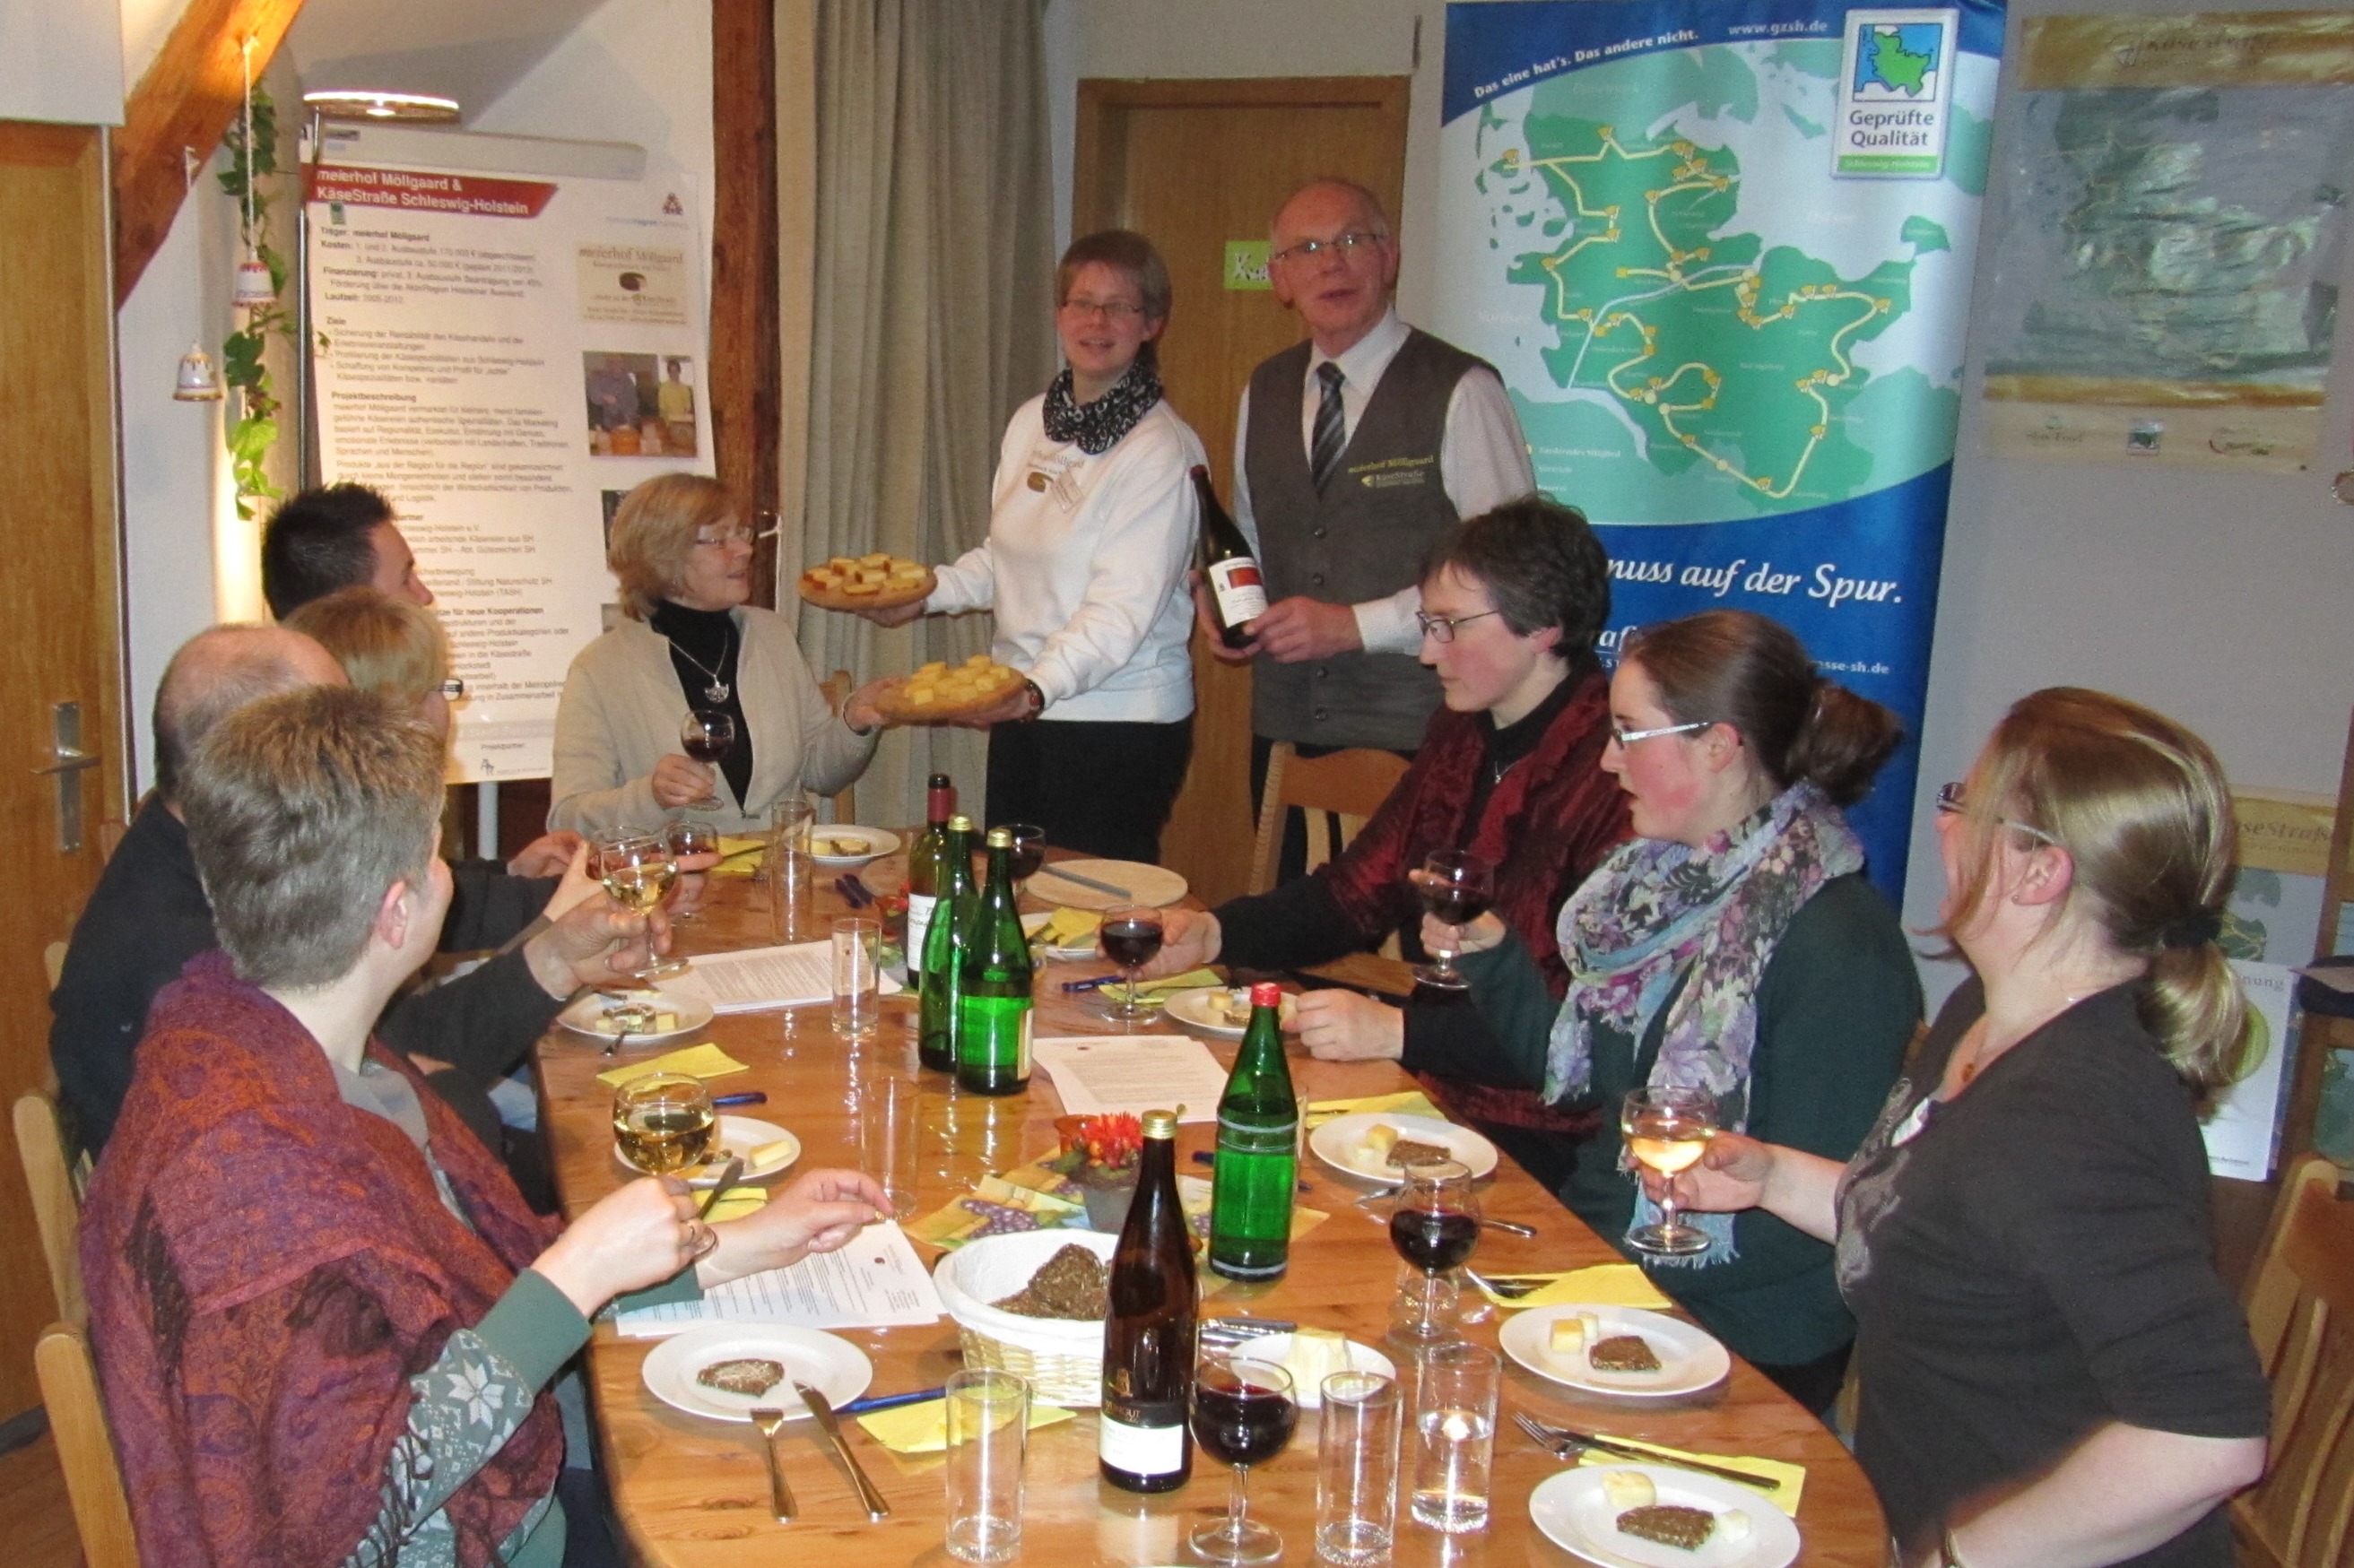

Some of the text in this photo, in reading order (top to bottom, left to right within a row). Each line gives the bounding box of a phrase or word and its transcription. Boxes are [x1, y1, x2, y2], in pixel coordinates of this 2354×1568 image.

[1728, 20, 1828, 36] www.gzsh.de
[1473, 30, 1699, 99] Das eine hat's. Das andere nicht.
[1849, 109, 1934, 130] Geprüfte
[1851, 130, 1928, 148] Qualität
[317, 169, 463, 192] meierhof Möllgaard &
[317, 186, 529, 214] KäseStraße Schleswig-Holstein
[332, 392, 416, 403] Projektbeschreibung
[1607, 559, 1902, 608] nuss auf der Spur.
